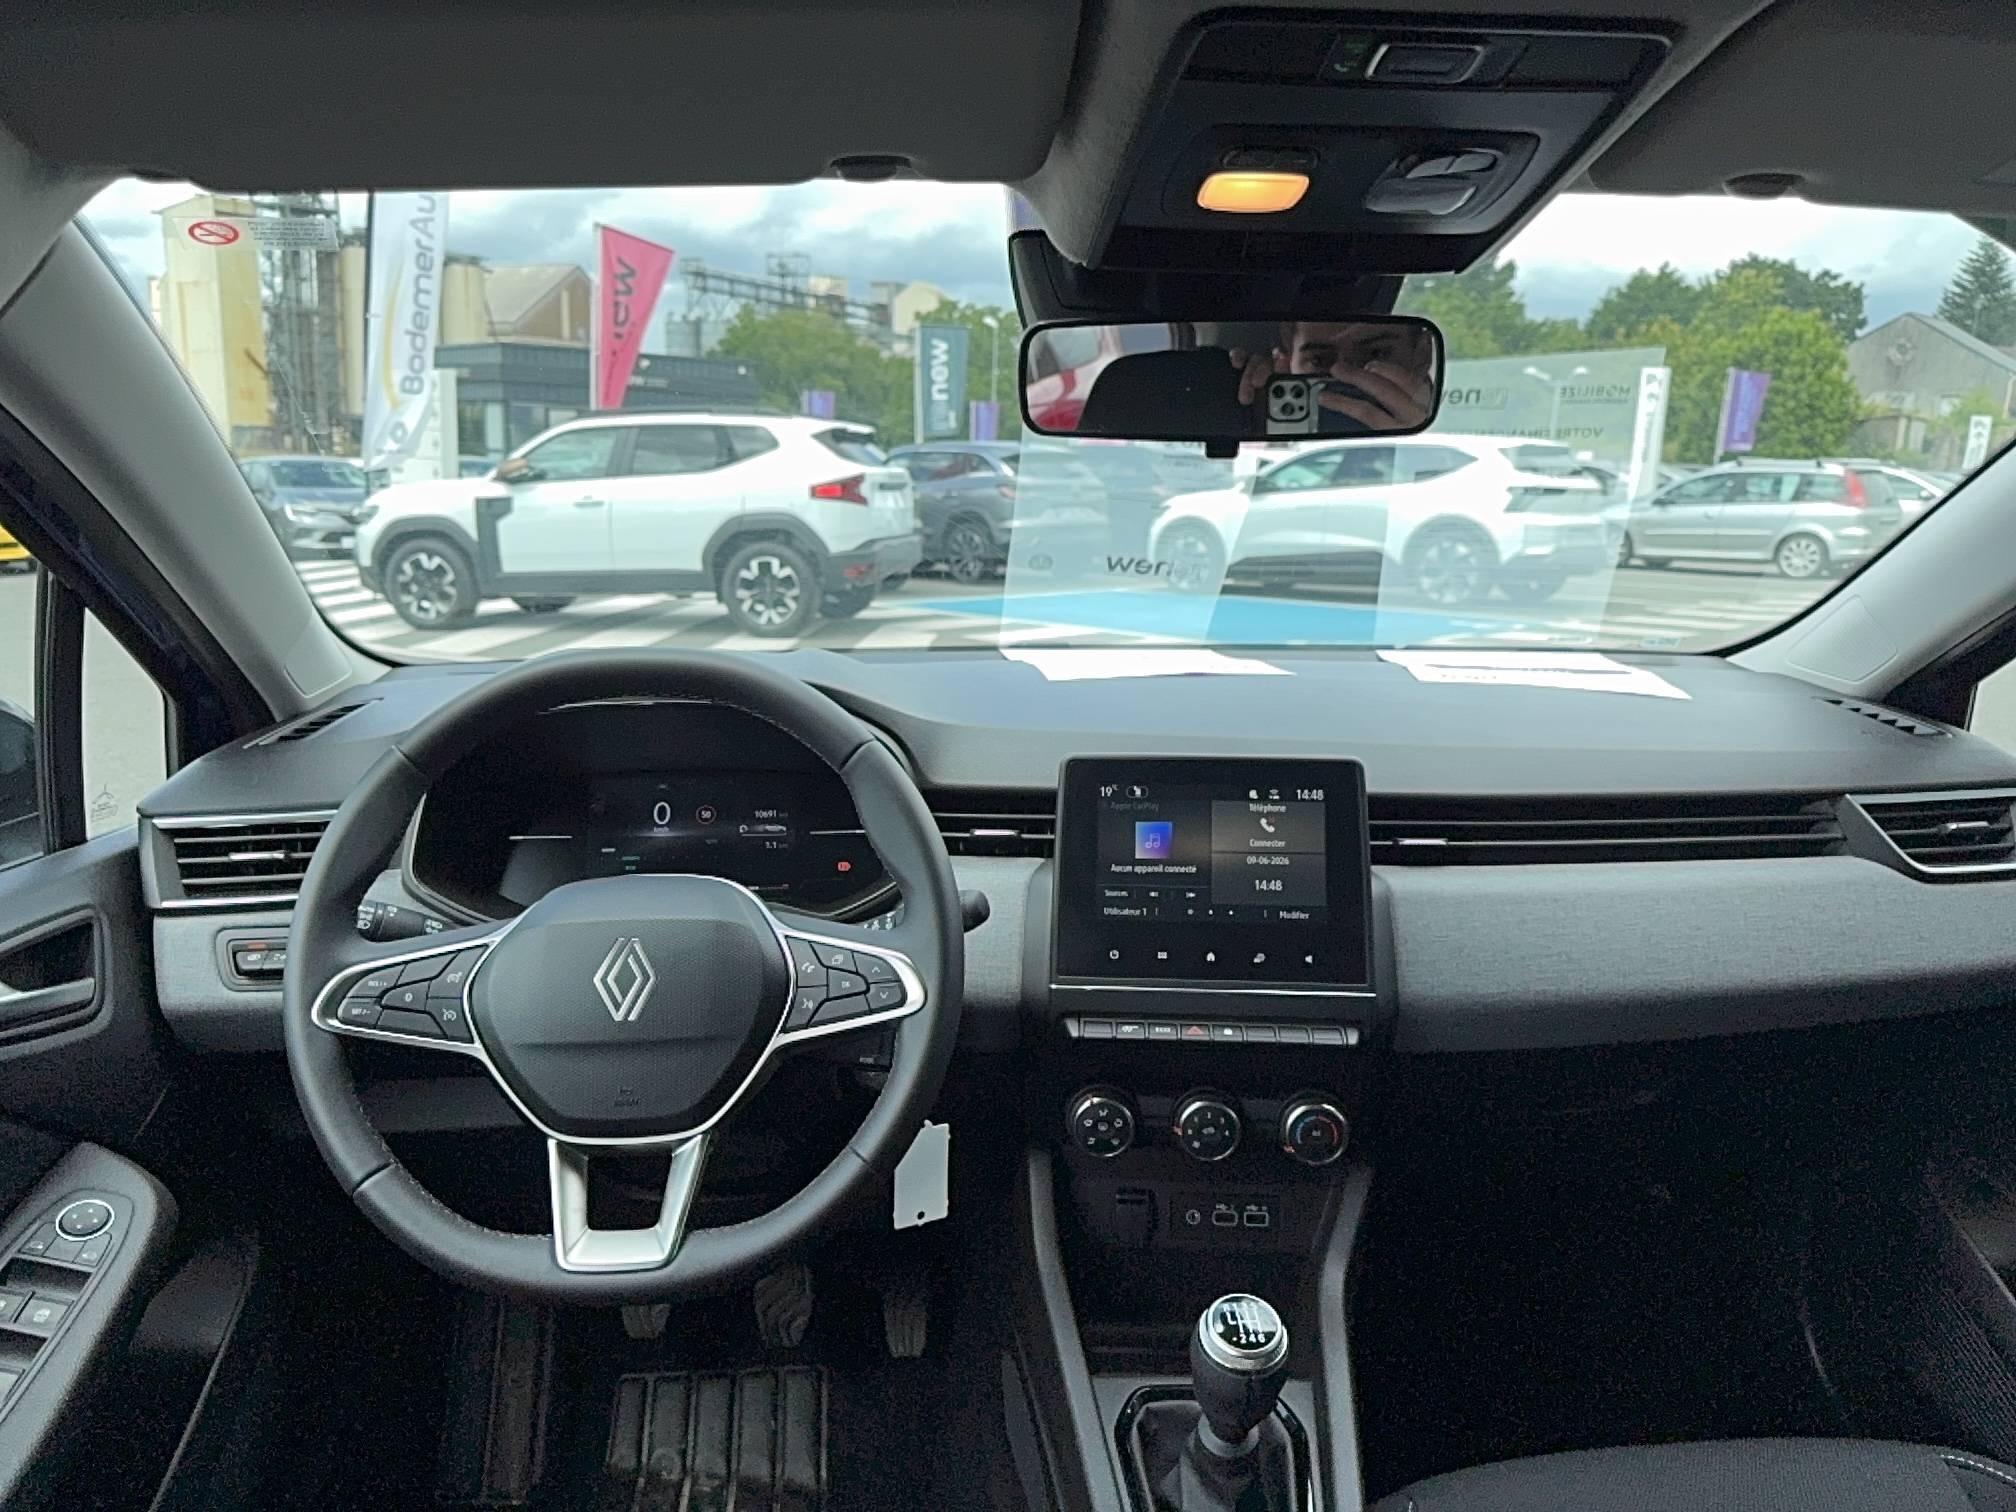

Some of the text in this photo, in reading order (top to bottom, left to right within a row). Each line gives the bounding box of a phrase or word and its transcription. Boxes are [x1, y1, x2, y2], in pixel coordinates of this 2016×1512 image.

[1296, 789, 1324, 800] 14:48
[653, 801, 671, 825] 0
[1255, 880, 1283, 891] 14:48
